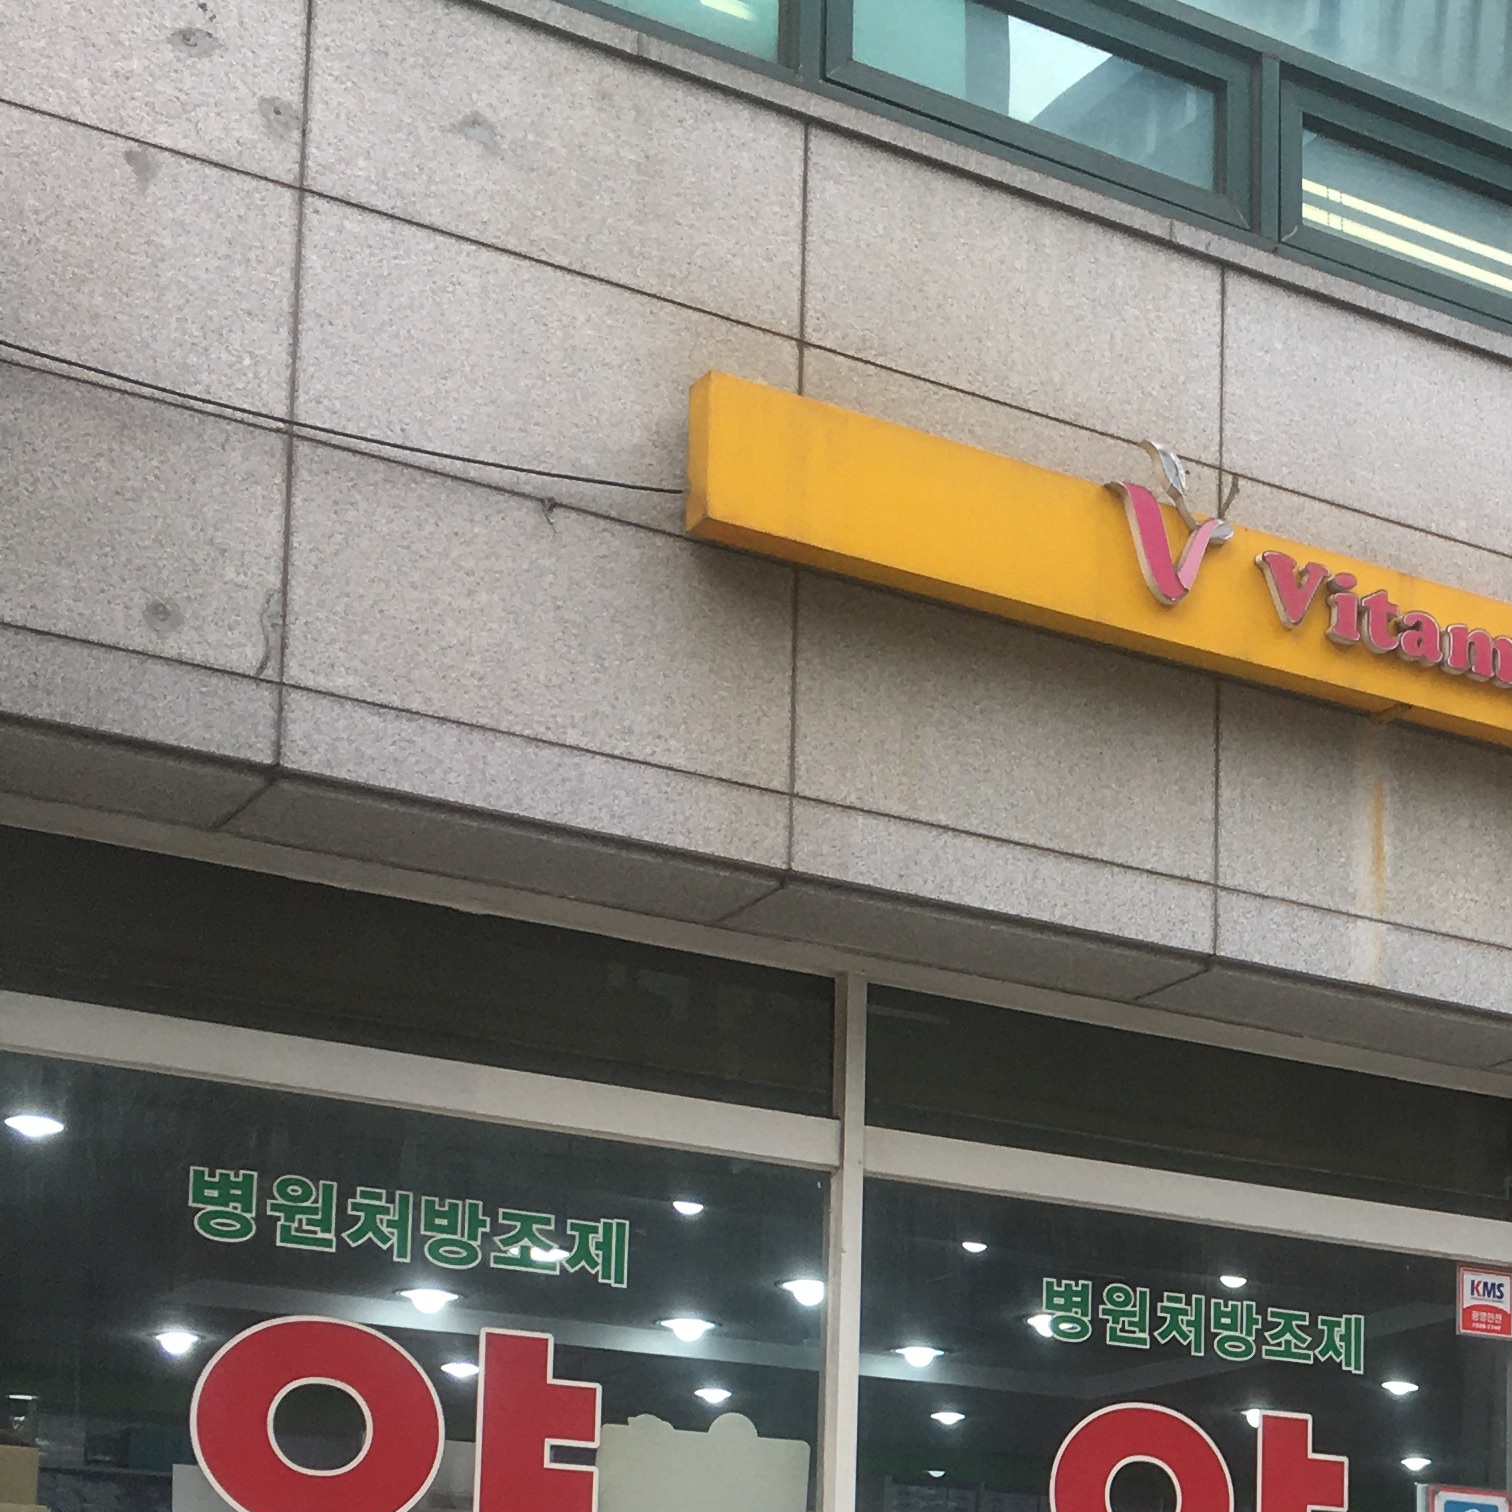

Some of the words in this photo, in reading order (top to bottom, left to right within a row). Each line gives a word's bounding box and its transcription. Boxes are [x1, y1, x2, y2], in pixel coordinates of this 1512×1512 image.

[188, 1165, 630, 1288] 병원처방조제
[1042, 1276, 1366, 1375] 병원처방조제
[1470, 1279, 1505, 1300] KMS
